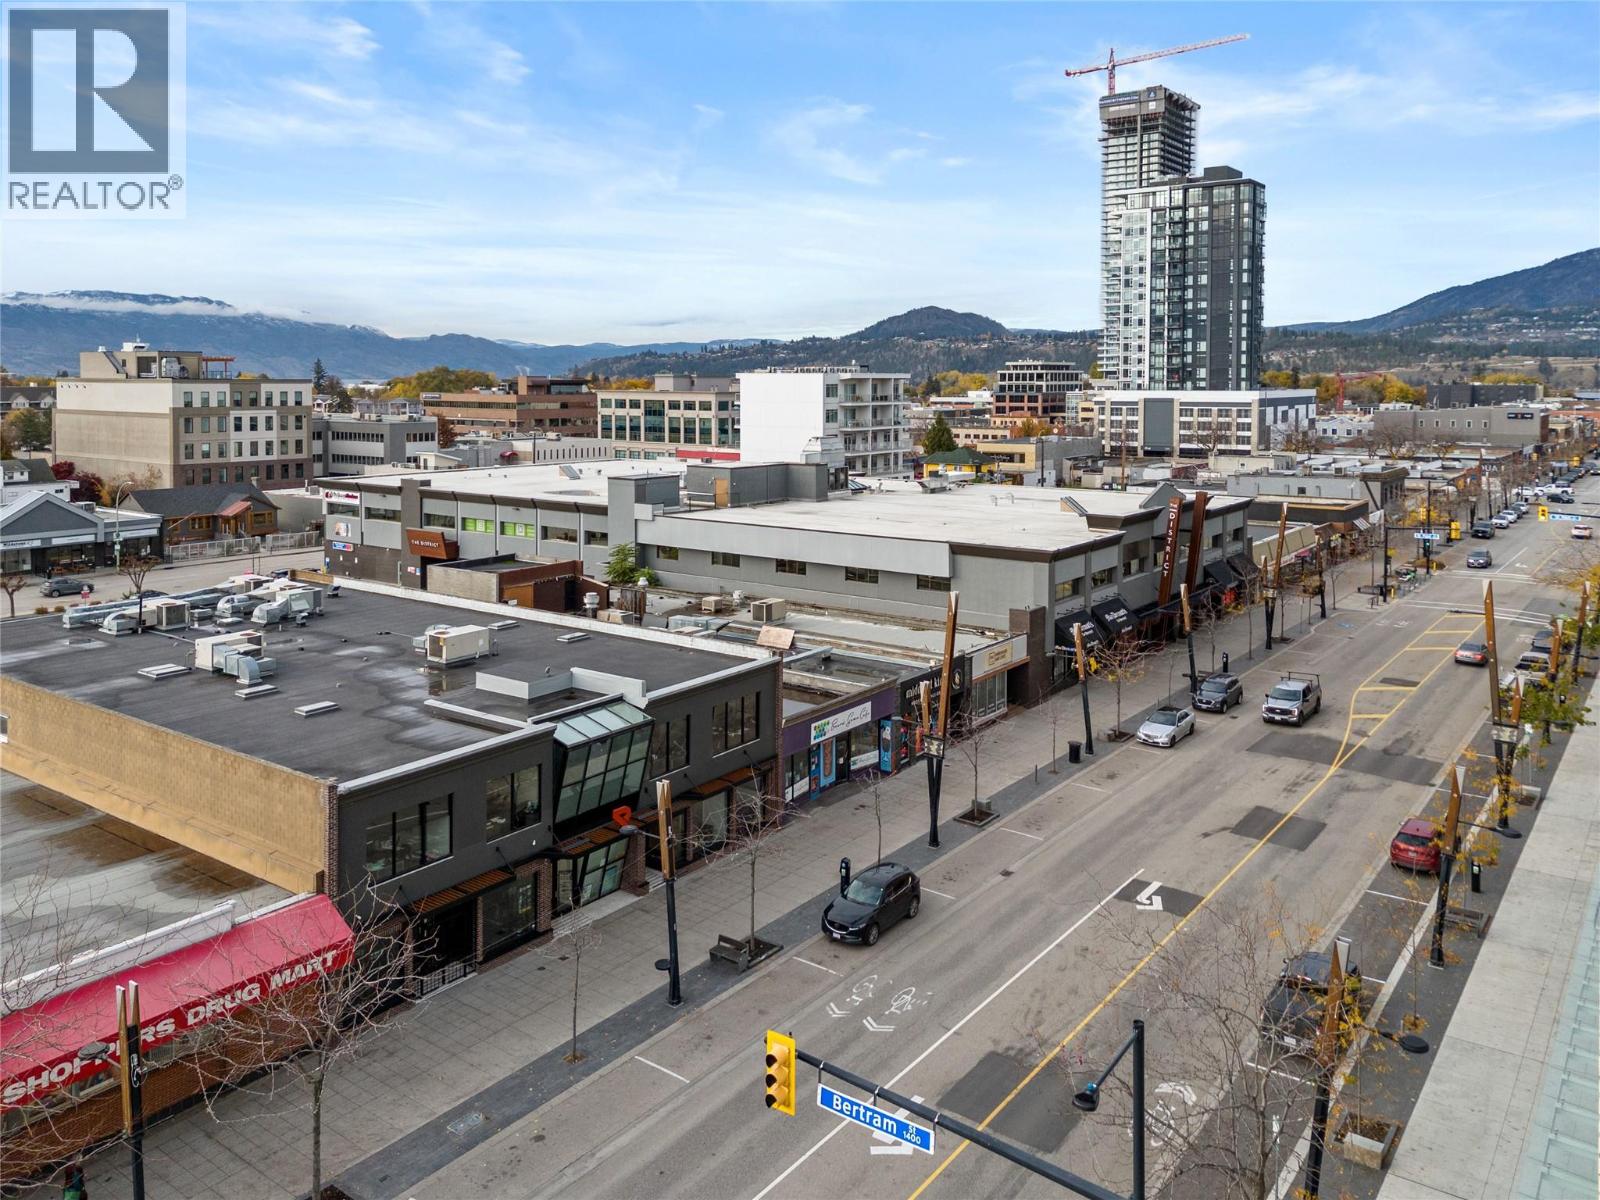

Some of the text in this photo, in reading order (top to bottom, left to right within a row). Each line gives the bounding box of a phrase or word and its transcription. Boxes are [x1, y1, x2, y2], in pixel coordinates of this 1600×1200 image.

[1162, 512, 1176, 577] DISTRICT
[187, 983, 260, 1026] DRUG
[271, 950, 337, 990] MART
[832, 1094, 897, 1135] Bertram
[903, 1130, 921, 1145] 1400
